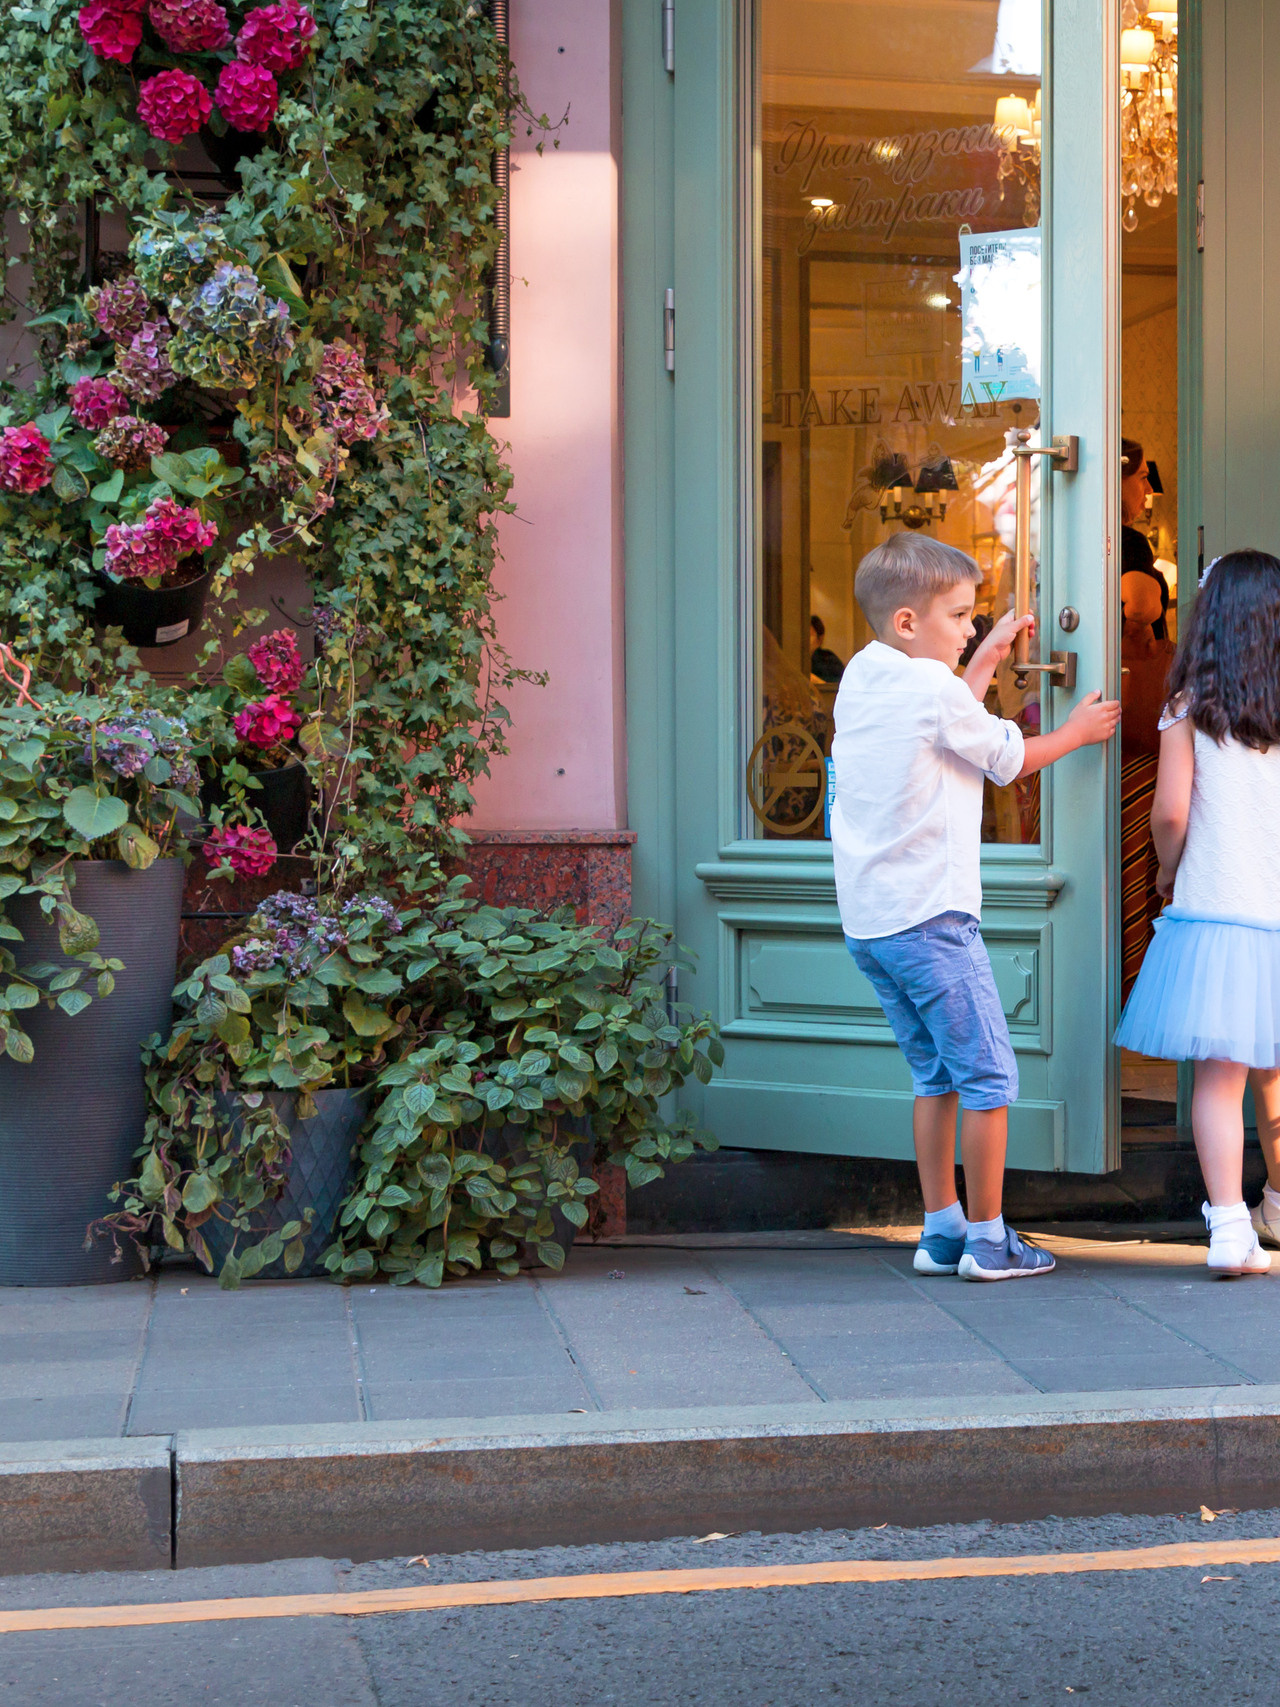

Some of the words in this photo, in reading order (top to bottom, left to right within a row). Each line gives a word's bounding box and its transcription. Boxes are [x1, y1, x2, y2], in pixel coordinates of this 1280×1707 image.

[798, 177, 985, 257] завтраки
[776, 387, 882, 429] TAKE
[891, 380, 1008, 424] AWAY
